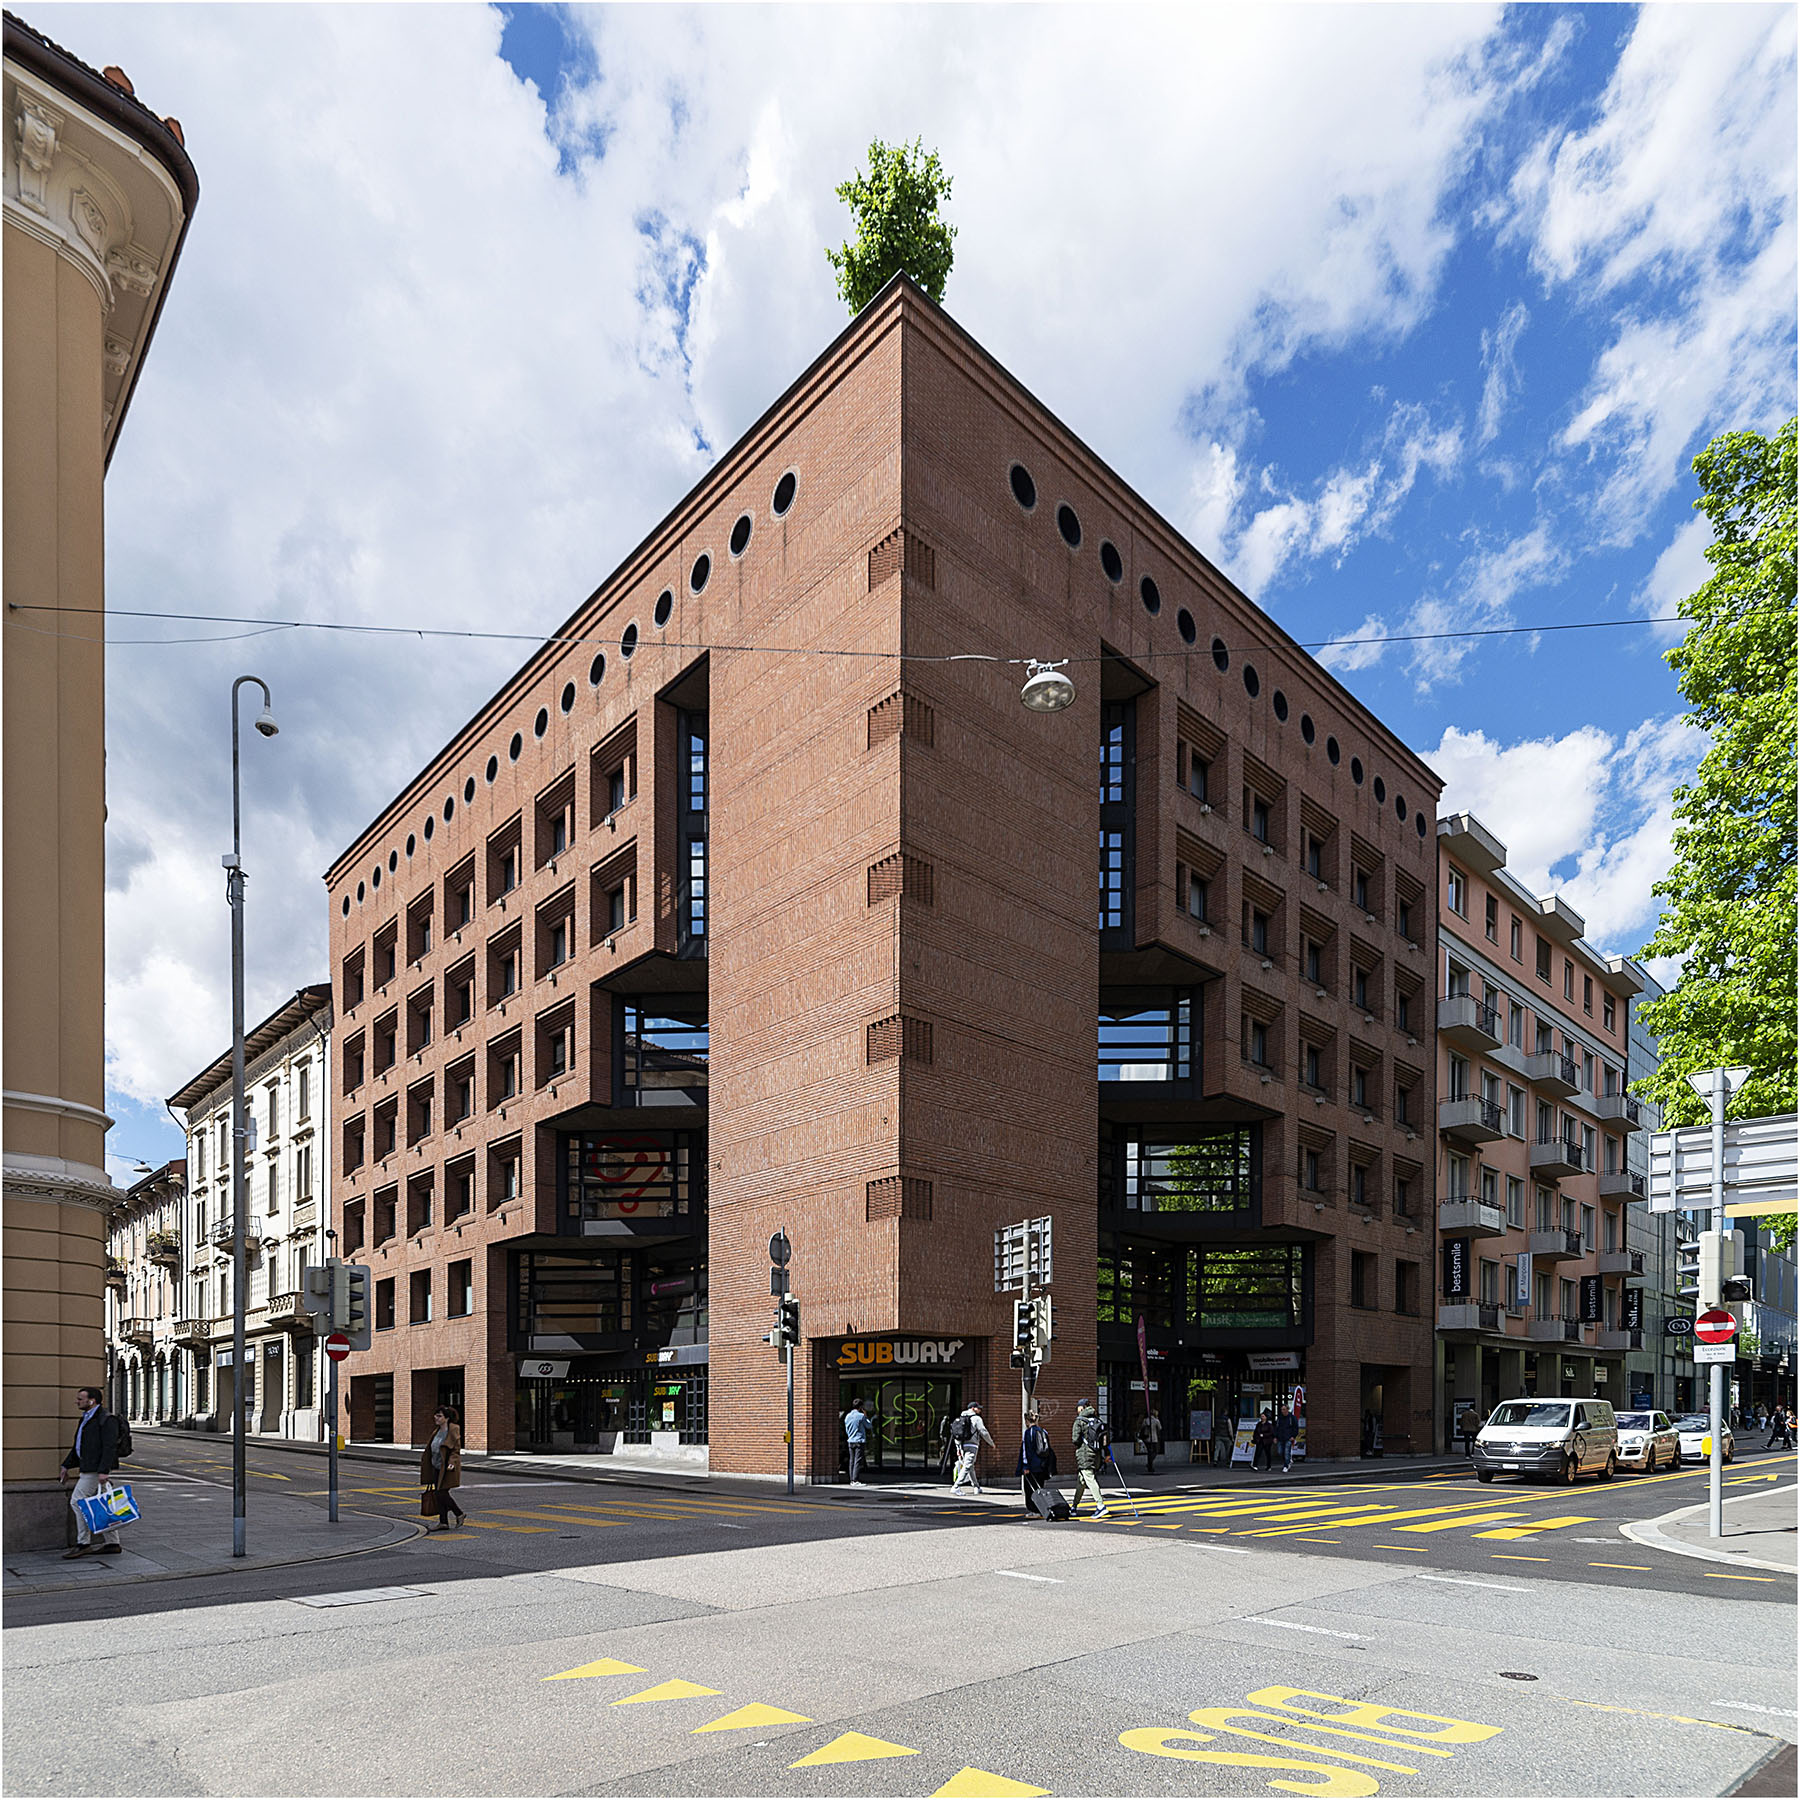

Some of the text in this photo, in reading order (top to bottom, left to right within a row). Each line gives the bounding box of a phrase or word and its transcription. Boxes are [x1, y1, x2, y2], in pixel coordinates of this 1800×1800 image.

[1451, 1242, 1462, 1292] bestsmile
[1587, 1279, 1597, 1319] bestsmile
[1628, 1306, 1639, 1328] Salt.
[836, 1339, 964, 1366] SUBWAY
[1118, 1685, 1504, 1798] BUS
